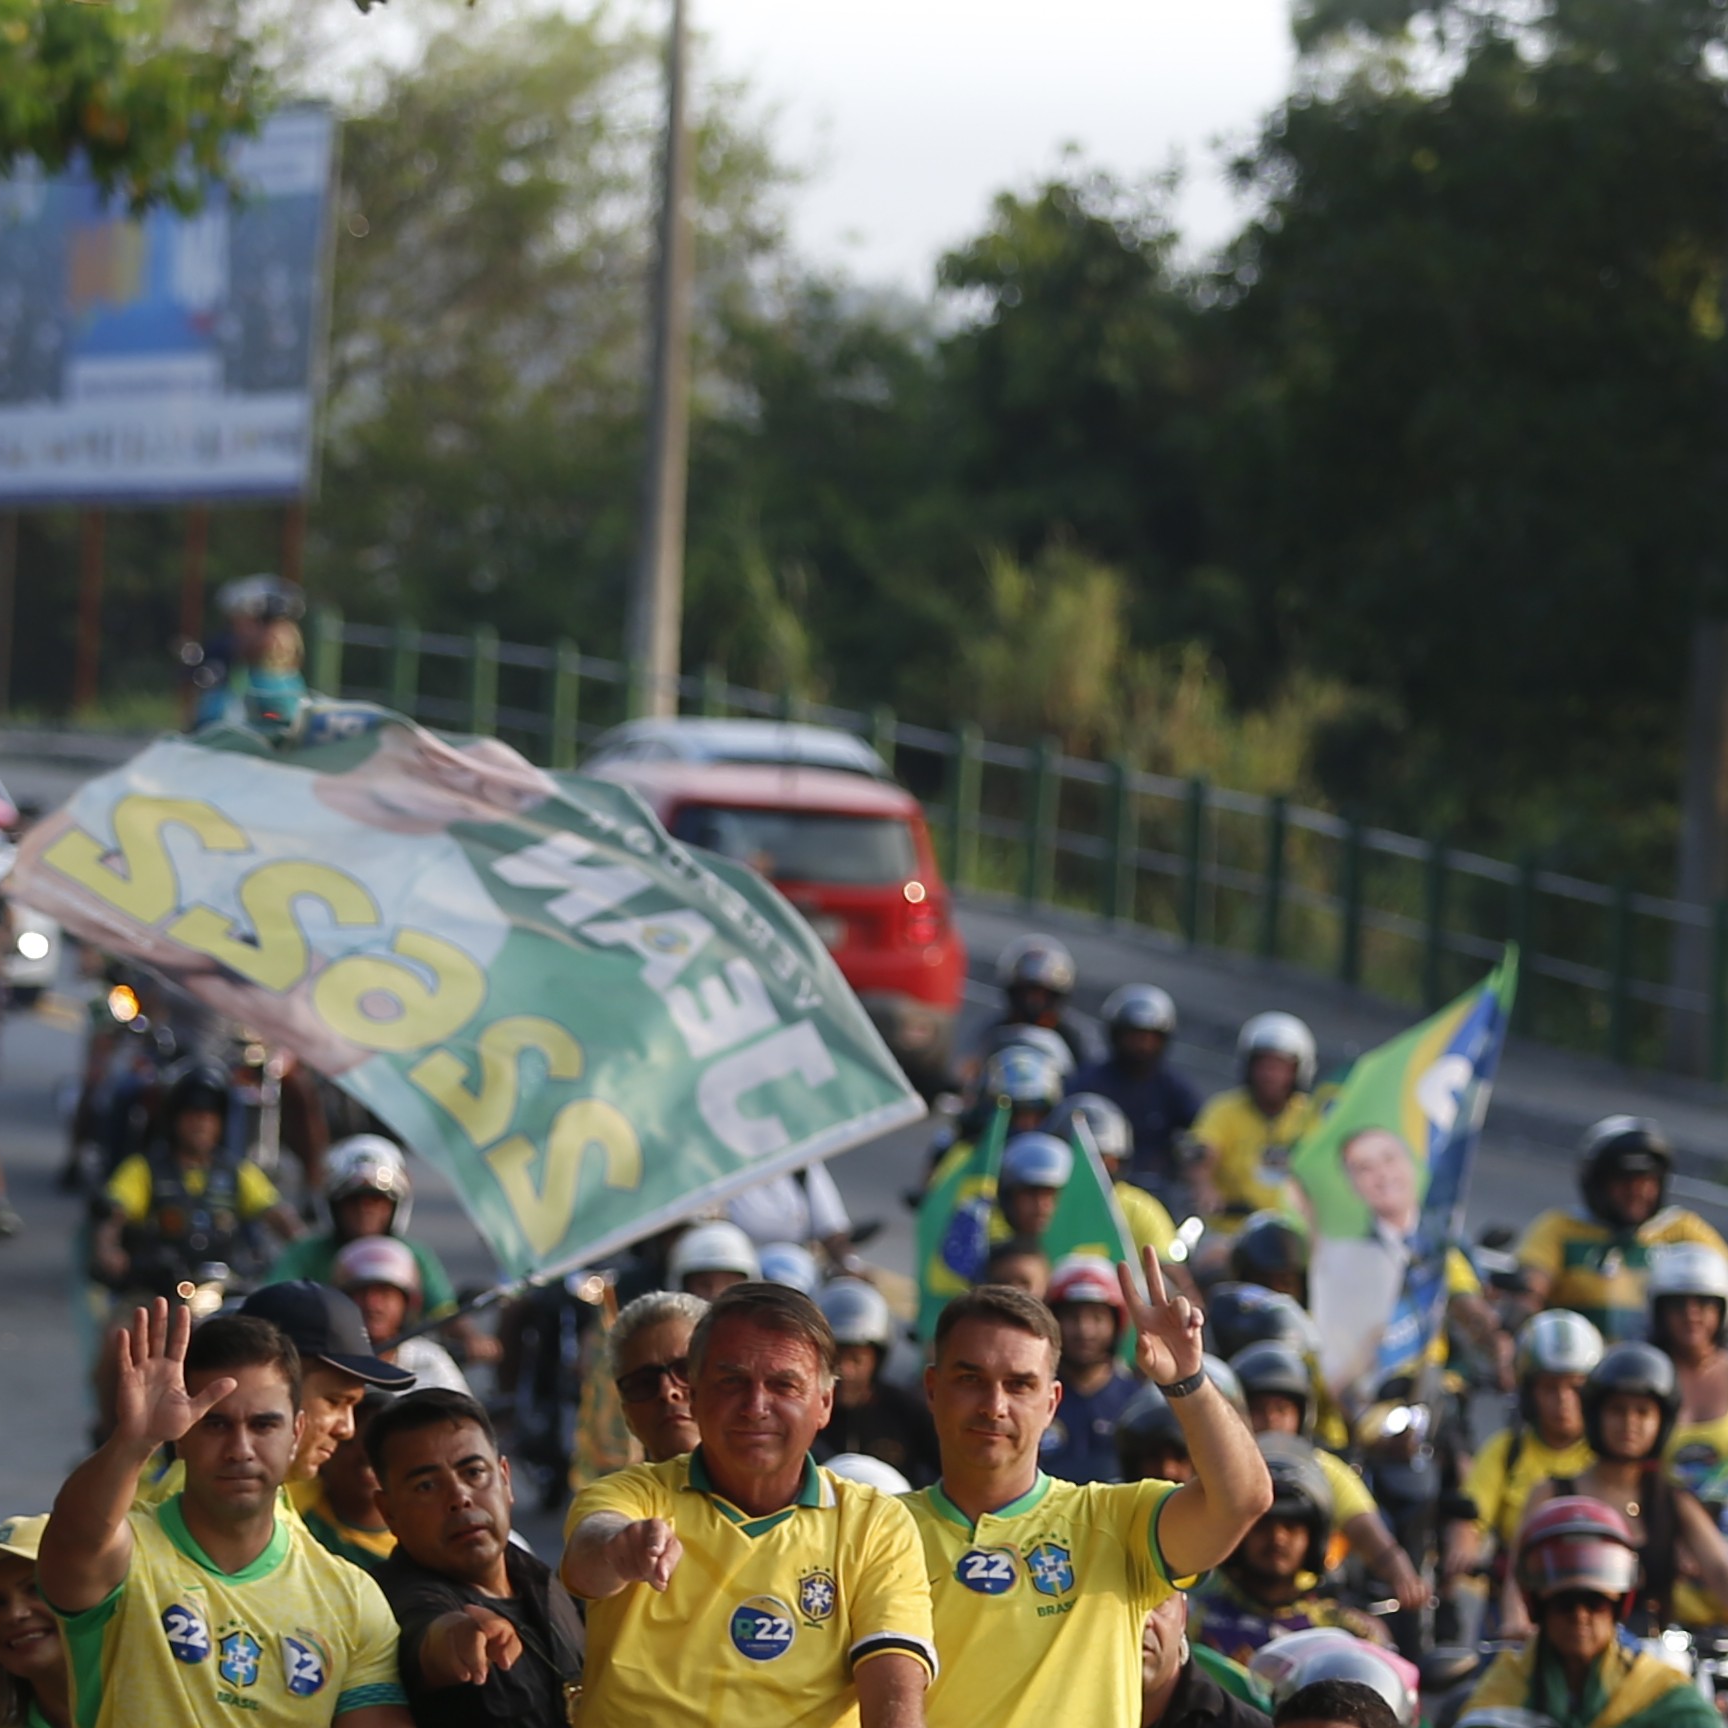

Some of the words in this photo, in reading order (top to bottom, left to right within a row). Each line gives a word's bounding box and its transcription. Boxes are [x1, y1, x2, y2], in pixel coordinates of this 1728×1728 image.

[966, 1554, 1011, 1580] 22
[166, 1613, 209, 1649] 22
[216, 1691, 259, 1711] BRASIL
